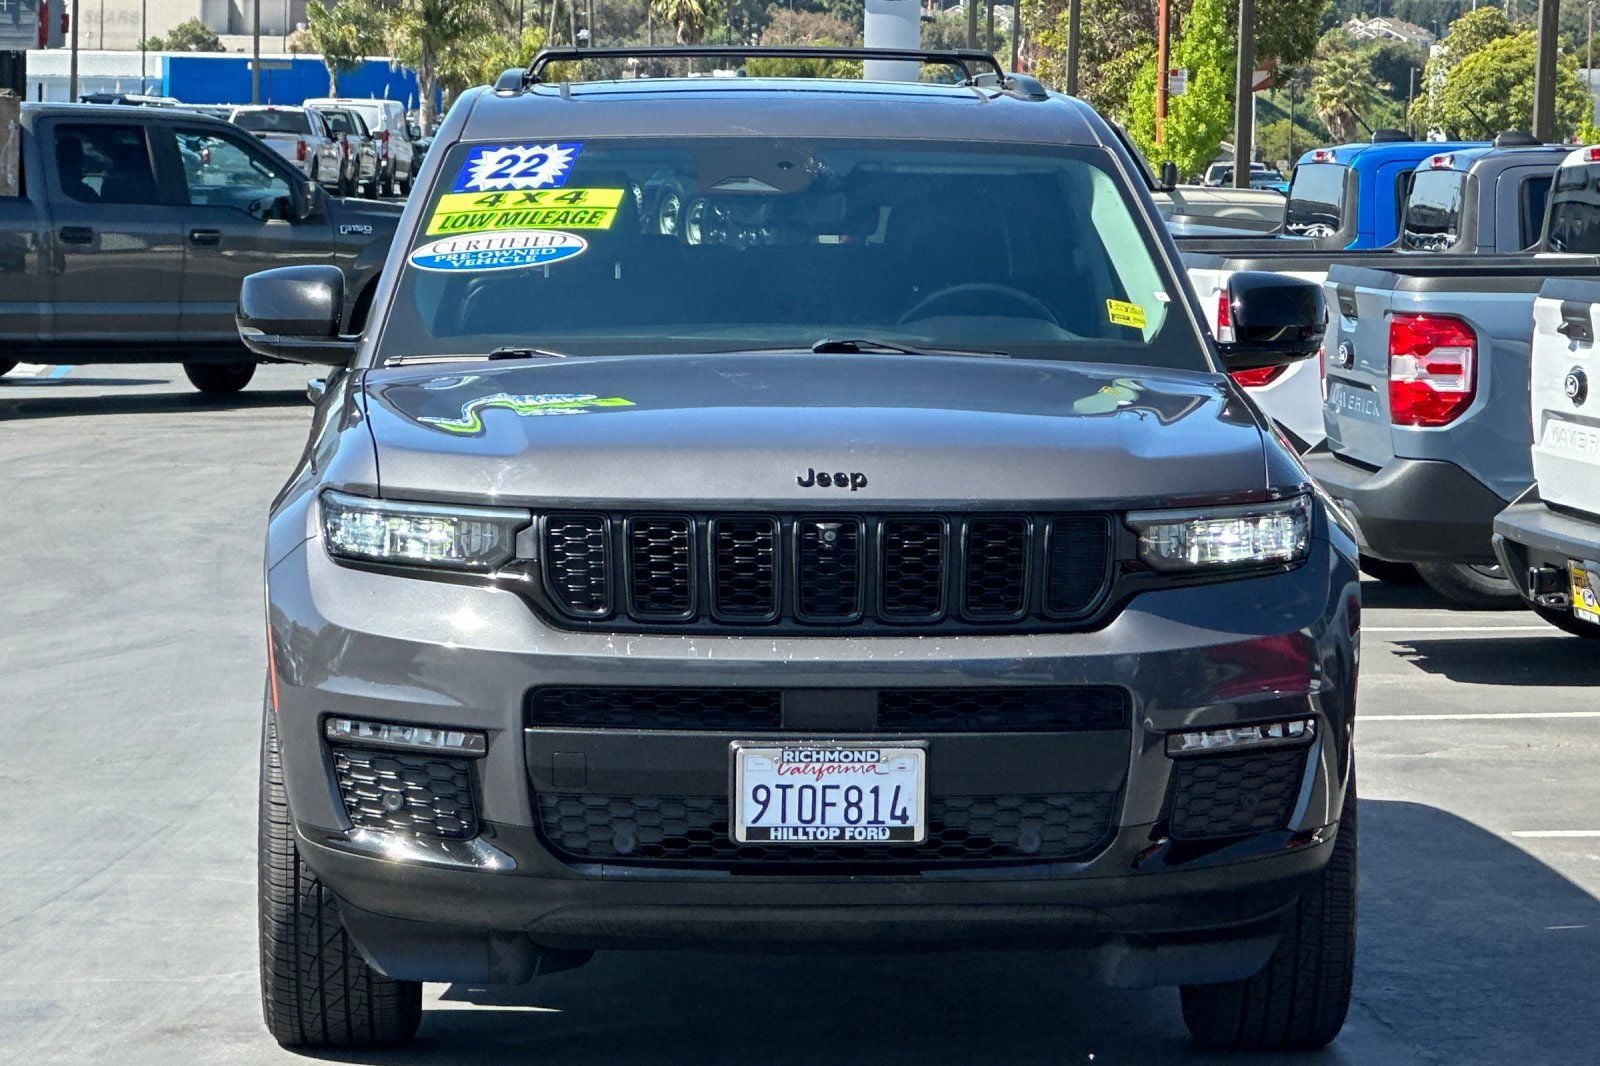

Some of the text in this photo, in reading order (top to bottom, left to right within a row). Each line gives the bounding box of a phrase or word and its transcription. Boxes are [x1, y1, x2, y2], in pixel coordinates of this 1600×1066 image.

[485, 153, 549, 180] 22
[438, 209, 605, 231] LOW MILEAGE
[432, 235, 567, 253] CERTIFIED
[433, 247, 557, 263] PRE-OWNED
[450, 255, 537, 267] VEHICLE
[797, 467, 868, 491] Jeep
[783, 750, 879, 763] RICHMOND
[777, 763, 889, 782] California
[770, 827, 890, 840] HILLTOP FORD
